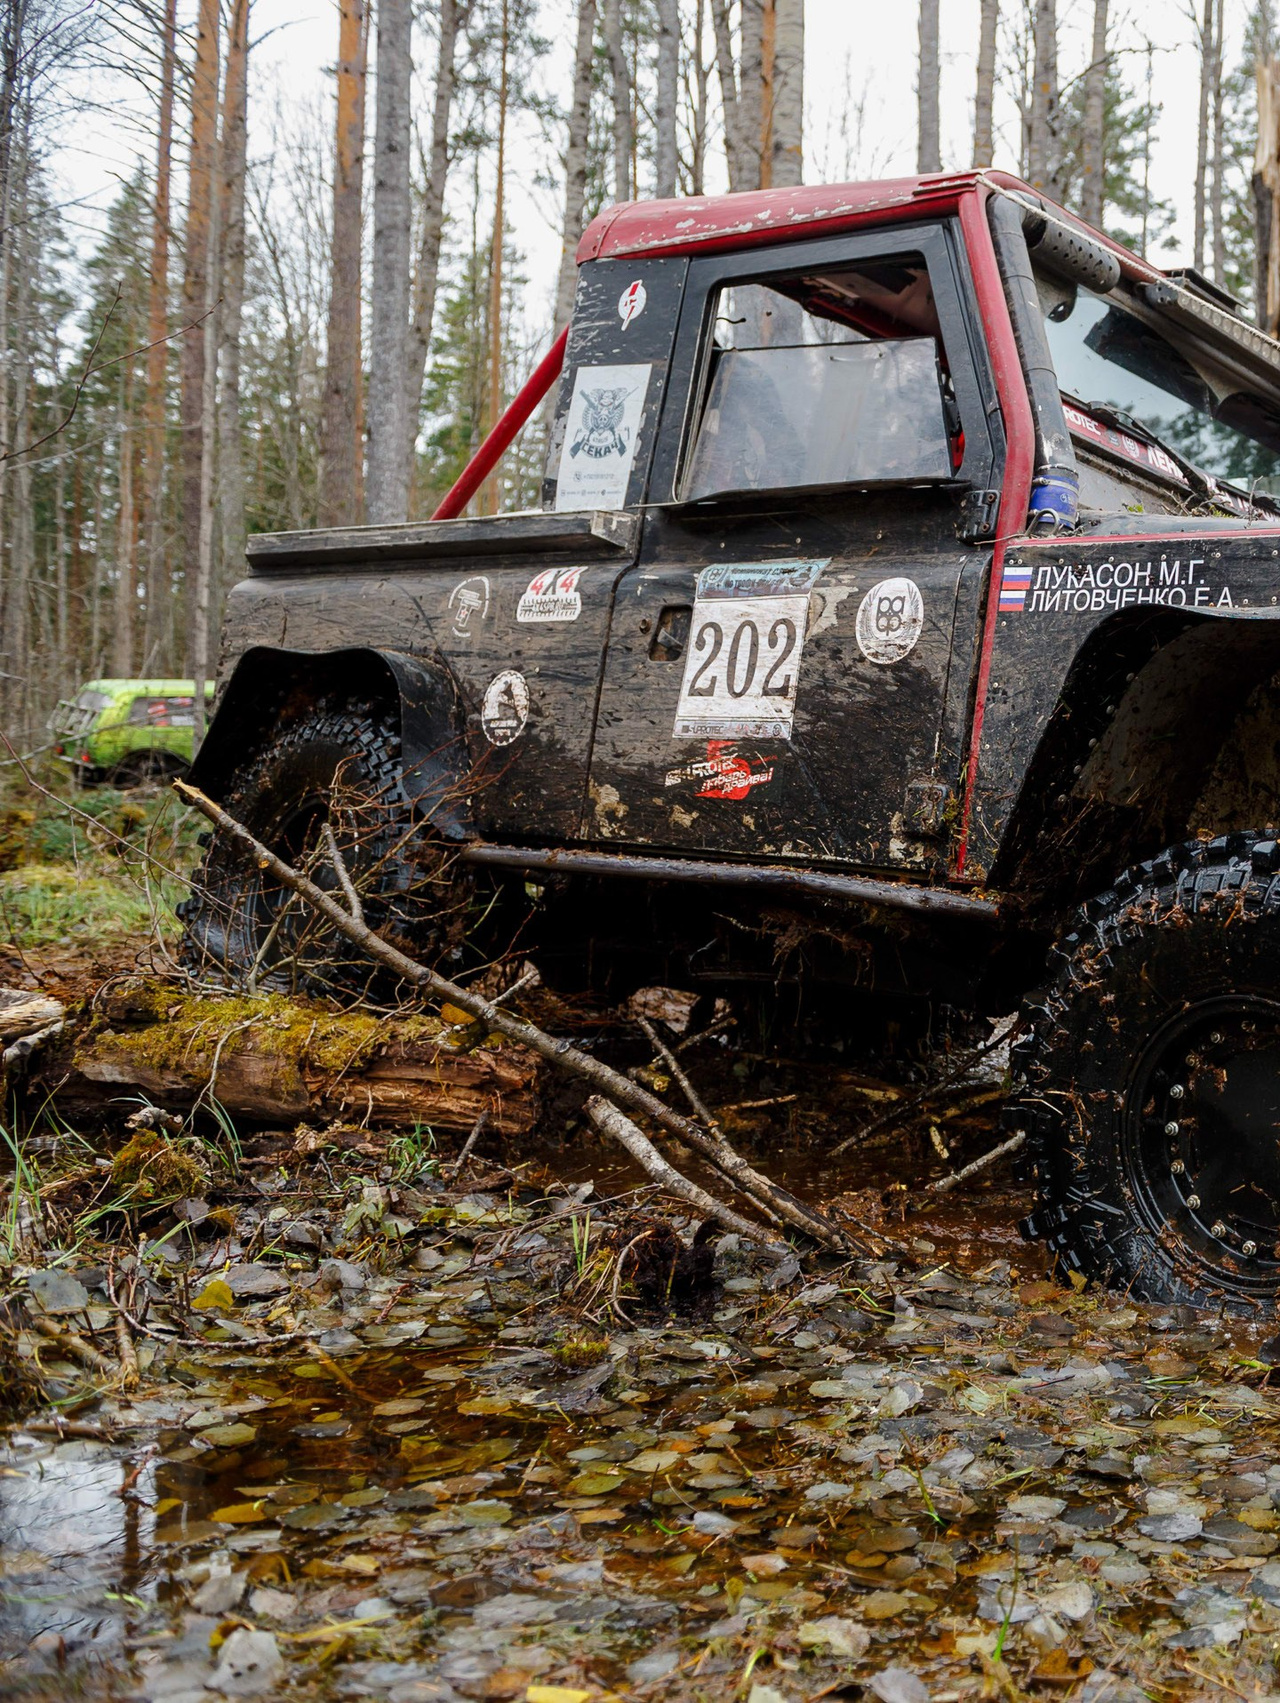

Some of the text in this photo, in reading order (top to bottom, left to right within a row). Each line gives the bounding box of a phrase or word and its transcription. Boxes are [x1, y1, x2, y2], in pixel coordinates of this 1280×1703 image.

[1062, 404, 1101, 436] ROTEC
[581, 442, 618, 457] СЕКАЧ
[1033, 559, 1205, 590] ЛУКАСОН М.Г.
[1028, 587, 1239, 613] ЛИТОВЧЕНКО ЕА.
[687, 617, 797, 699] 202
[689, 724, 724, 735] SUPROTEC
